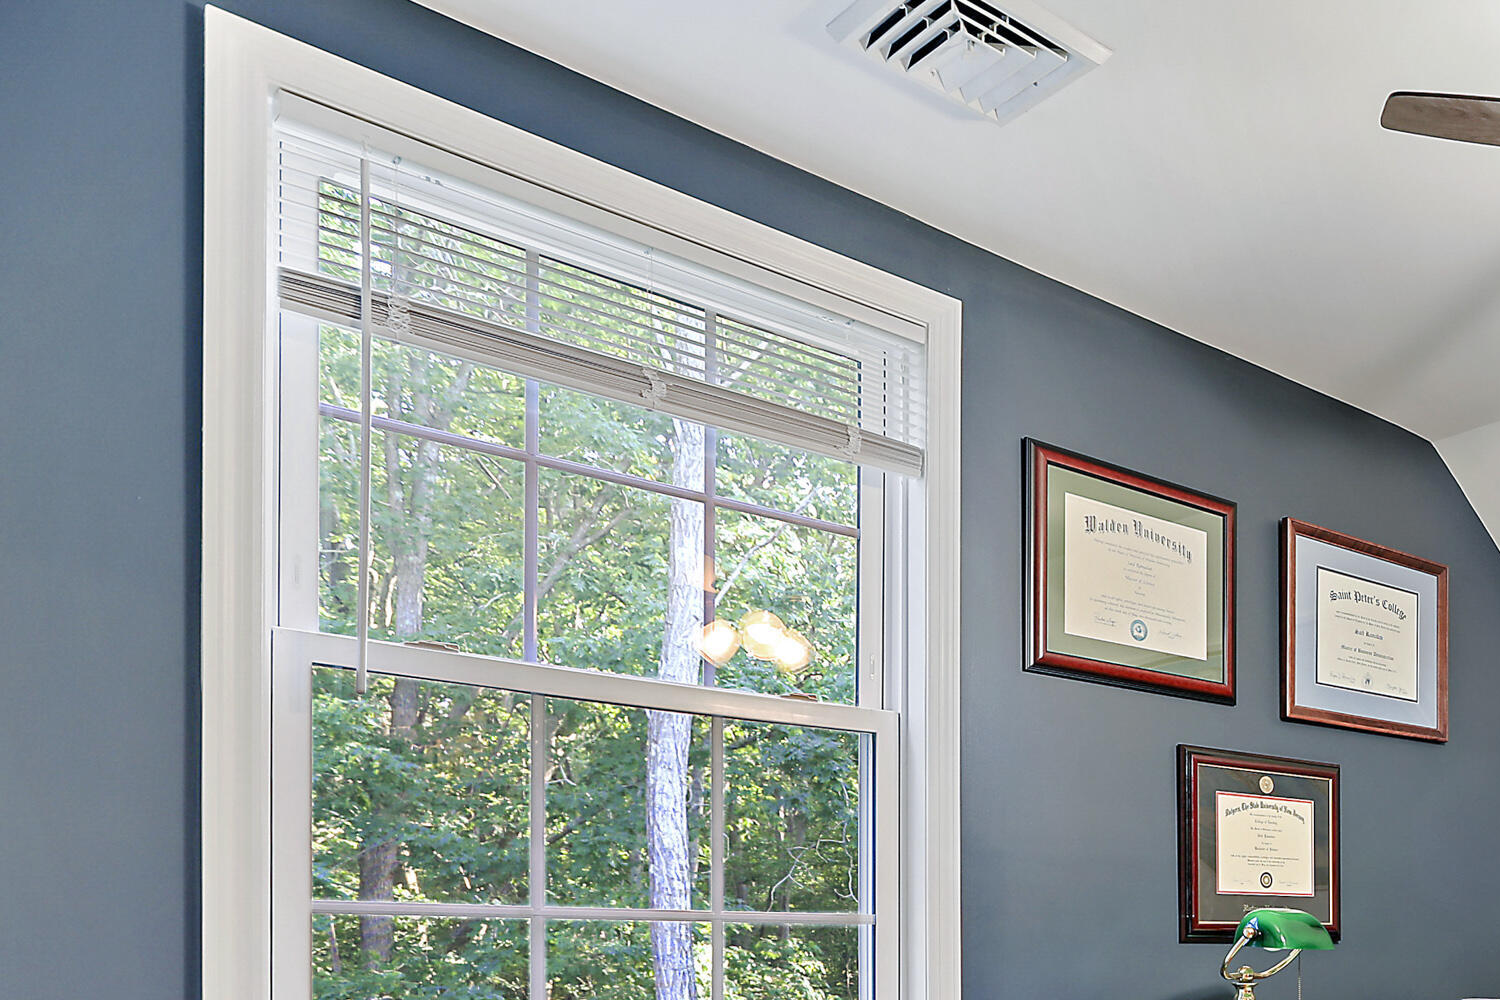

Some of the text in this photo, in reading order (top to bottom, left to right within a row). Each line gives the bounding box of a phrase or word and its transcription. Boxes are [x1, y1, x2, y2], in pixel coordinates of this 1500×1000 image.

[1084, 515, 1129, 535] Walden
[1133, 519, 1192, 564] University
[1330, 590, 1407, 620] Saint Peter's College
